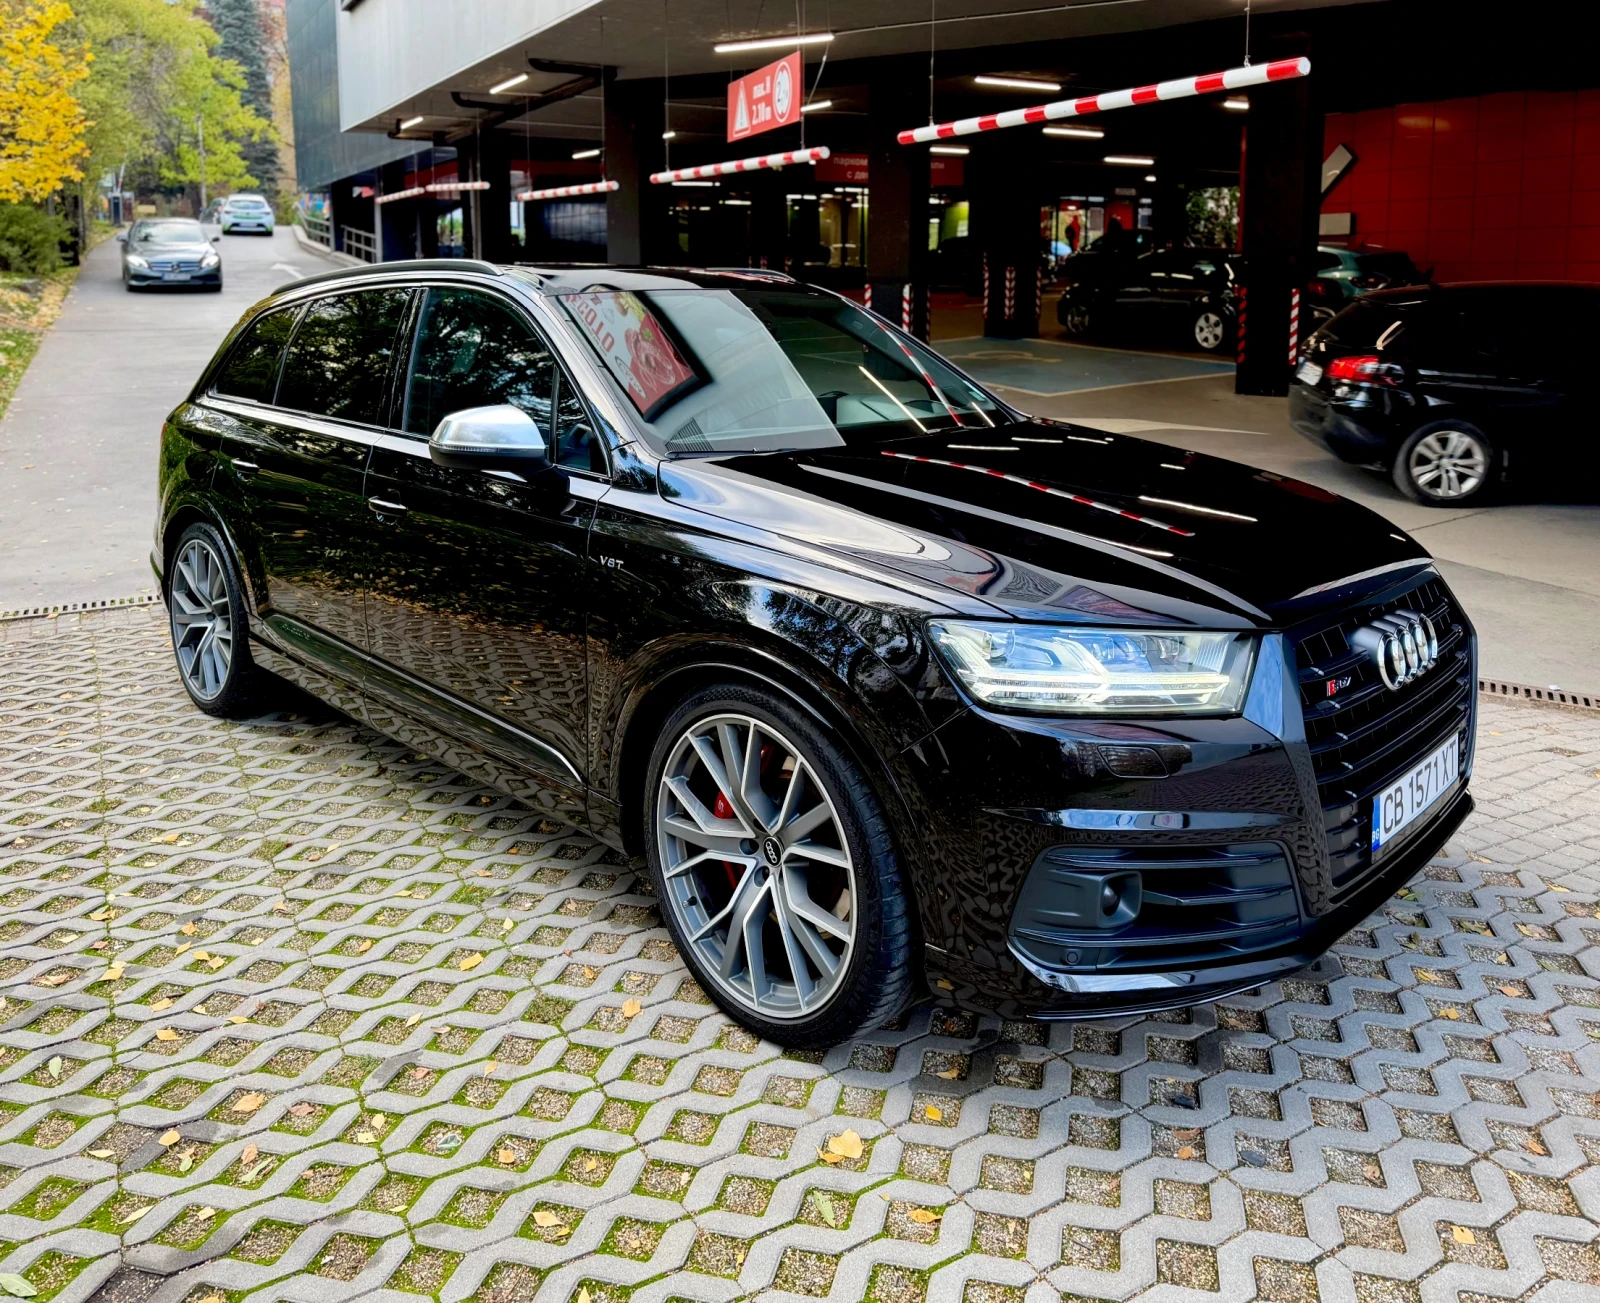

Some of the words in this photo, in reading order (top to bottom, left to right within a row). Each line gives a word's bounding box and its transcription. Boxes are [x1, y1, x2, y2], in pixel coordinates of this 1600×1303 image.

[1383, 785, 1404, 834] CB
[1408, 756, 1439, 814] 1571
[1441, 739, 1457, 786] XT
[1372, 828, 1380, 842] BG
